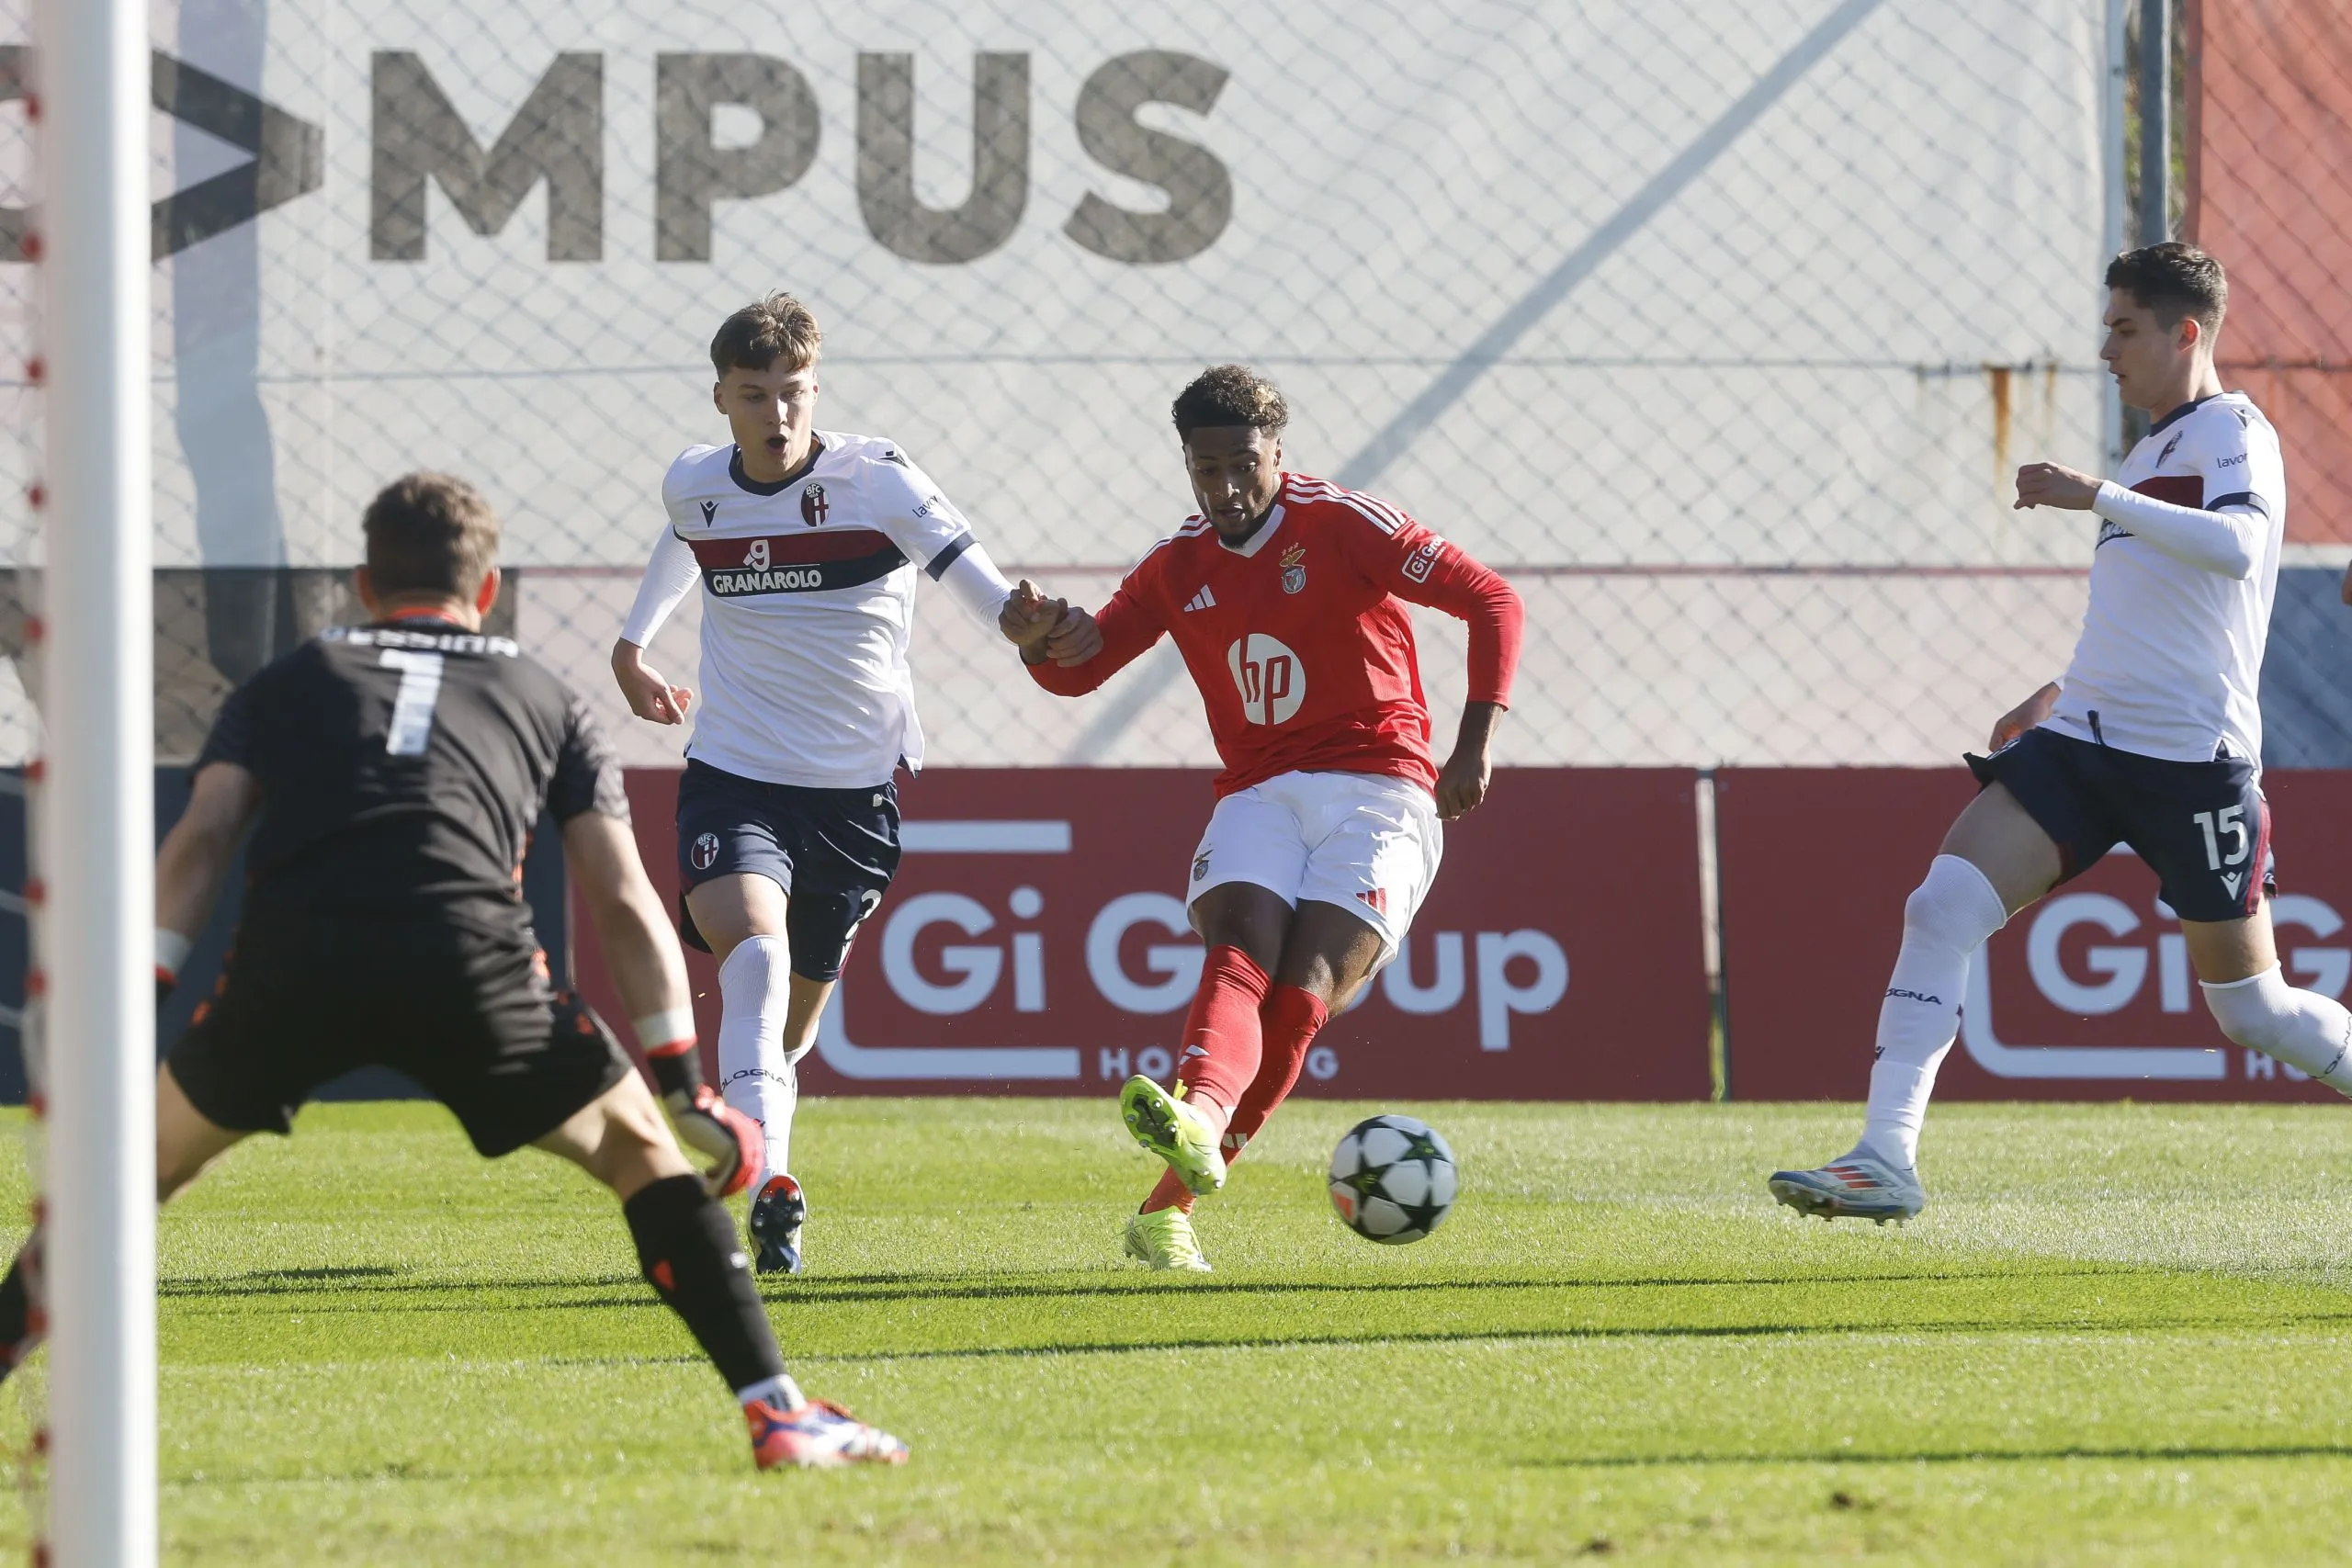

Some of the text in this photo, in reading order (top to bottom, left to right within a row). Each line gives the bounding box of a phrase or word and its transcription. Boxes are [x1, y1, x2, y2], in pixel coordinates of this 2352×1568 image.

[806, 484, 820, 495] BFC
[713, 570, 822, 593] GRANAROLO
[1411, 556, 1428, 574] Gi
[378, 648, 444, 755] 1
[1238, 633, 1293, 725] hp
[2193, 803, 2249, 871] 15
[880, 886, 1569, 1051] Gi Gup
[2027, 891, 2192, 1014] Gi
